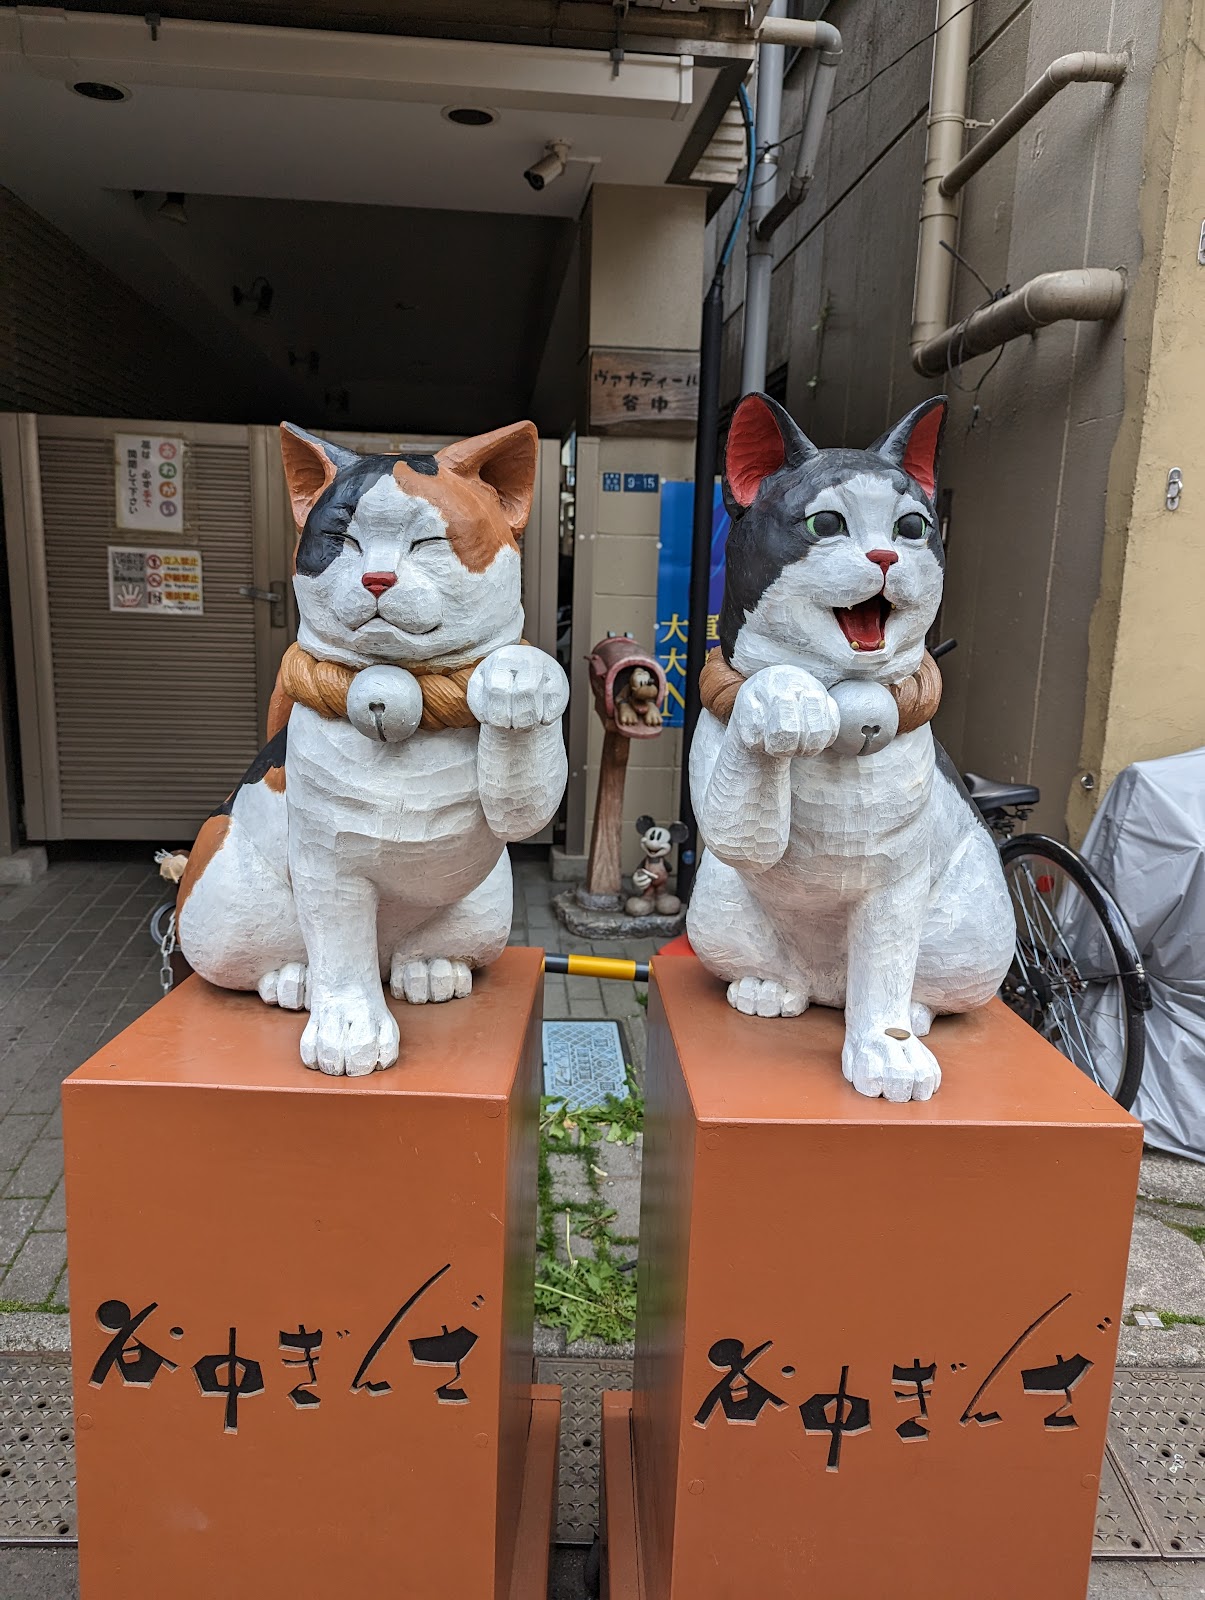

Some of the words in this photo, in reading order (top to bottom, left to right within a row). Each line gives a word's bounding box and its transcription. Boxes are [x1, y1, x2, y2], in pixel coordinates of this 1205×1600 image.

[594, 369, 698, 388] ヴァナディール
[622, 394, 668, 414] 谷中
[627, 476, 656, 489] 9-15
[163, 556, 199, 567] 立入禁止
[88, 1263, 486, 1435] 谷中ぎんざ
[693, 1293, 1113, 1473] 谷中ぎんざ
